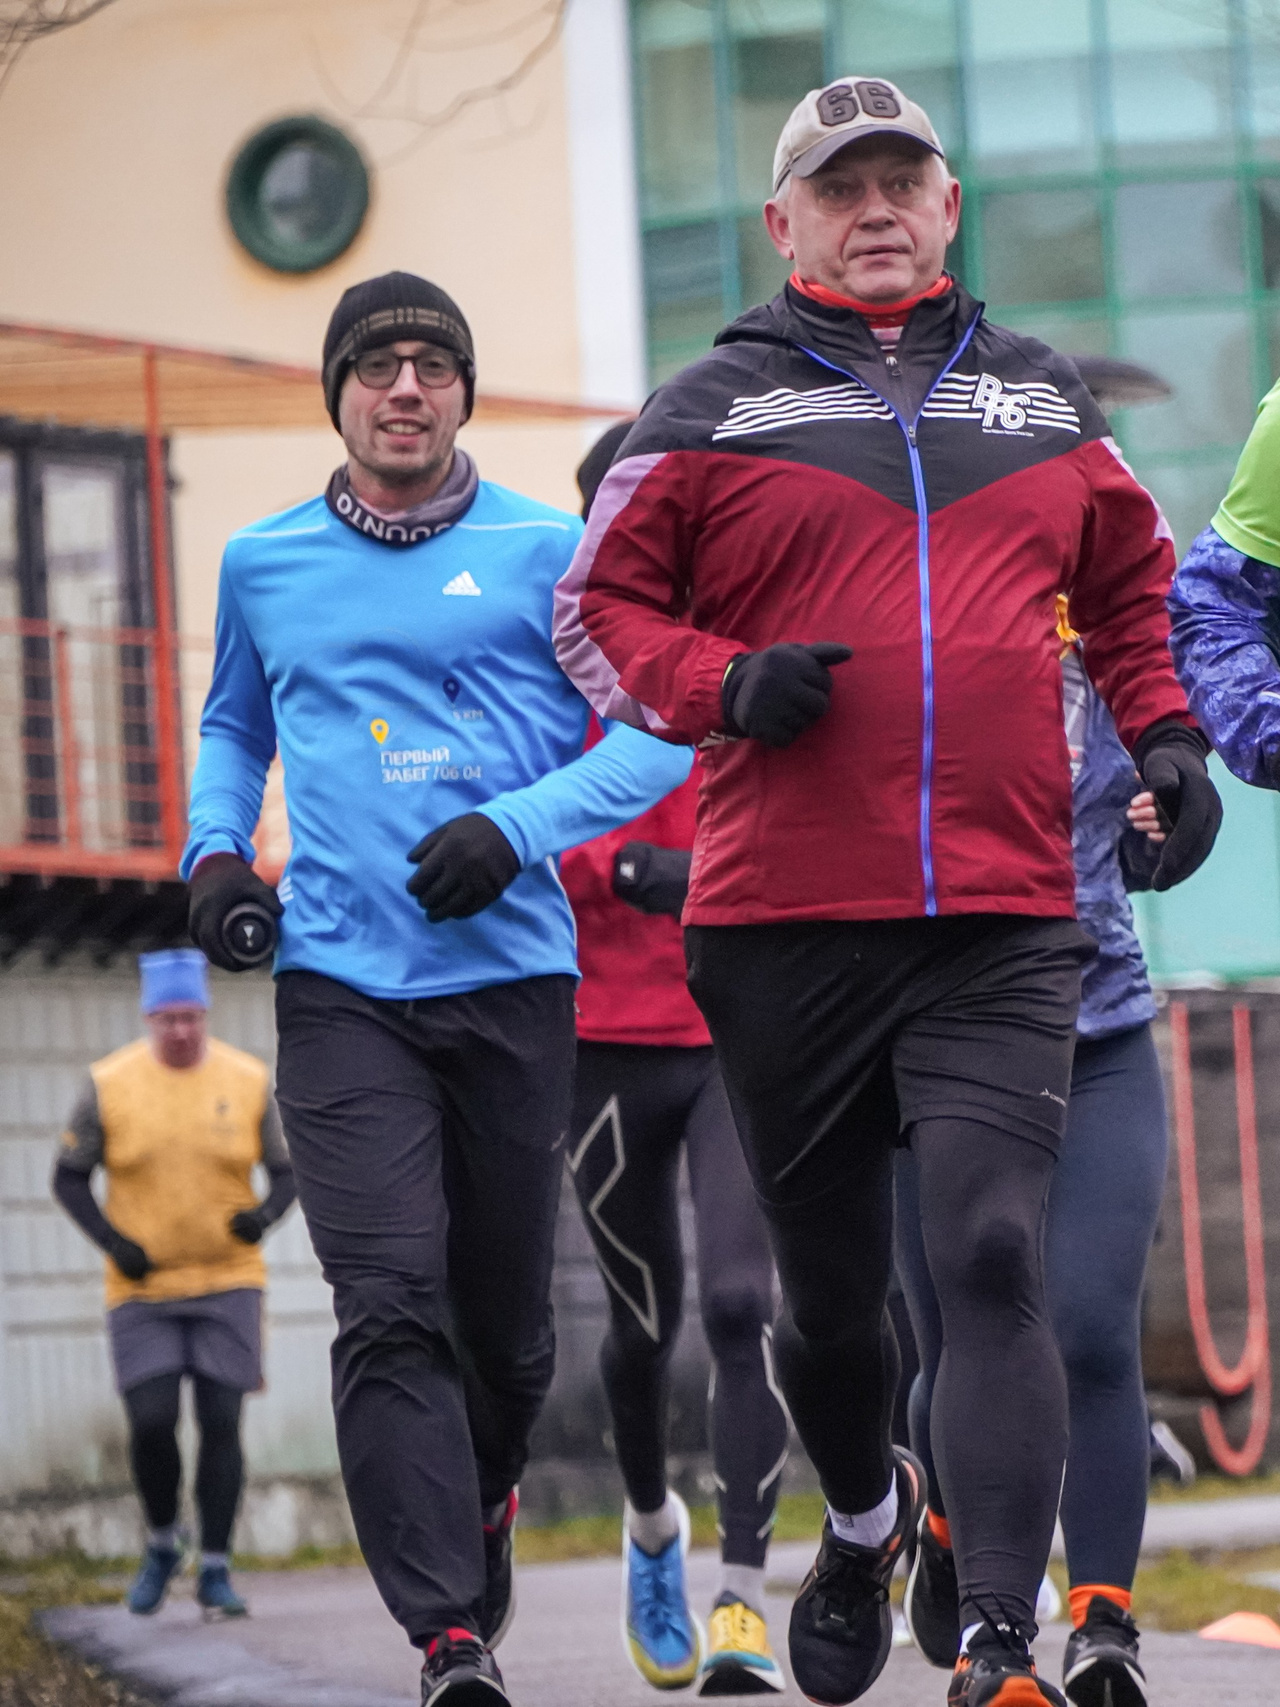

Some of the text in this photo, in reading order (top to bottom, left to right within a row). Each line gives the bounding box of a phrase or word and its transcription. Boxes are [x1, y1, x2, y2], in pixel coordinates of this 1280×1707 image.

[816, 80, 900, 126] 66
[380, 746, 449, 766] ПЕРВЫЙ
[382, 766, 430, 784] ЗАБЕГ
